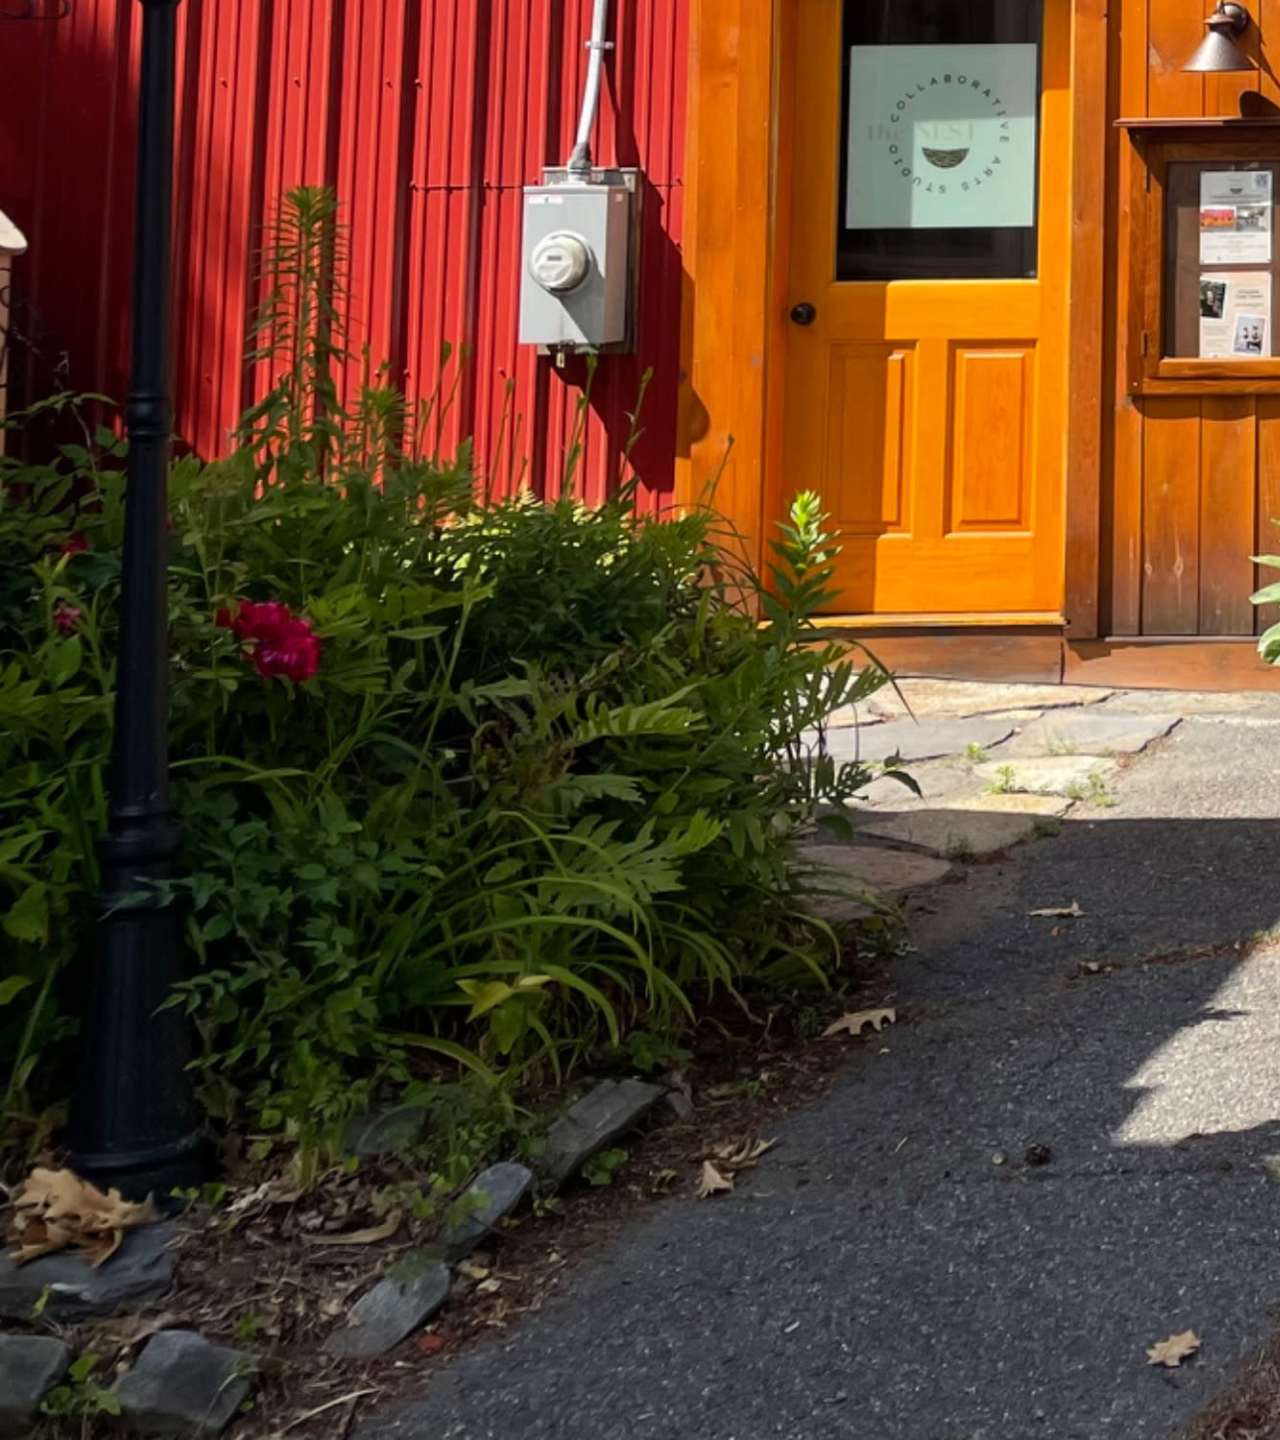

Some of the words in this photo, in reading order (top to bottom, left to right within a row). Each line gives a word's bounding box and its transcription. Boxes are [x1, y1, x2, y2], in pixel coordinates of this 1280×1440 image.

[890, 73, 1010, 143] COLLABORATIVE
[888, 143, 947, 194] STUDIO
[960, 155, 1001, 192] ARTS
